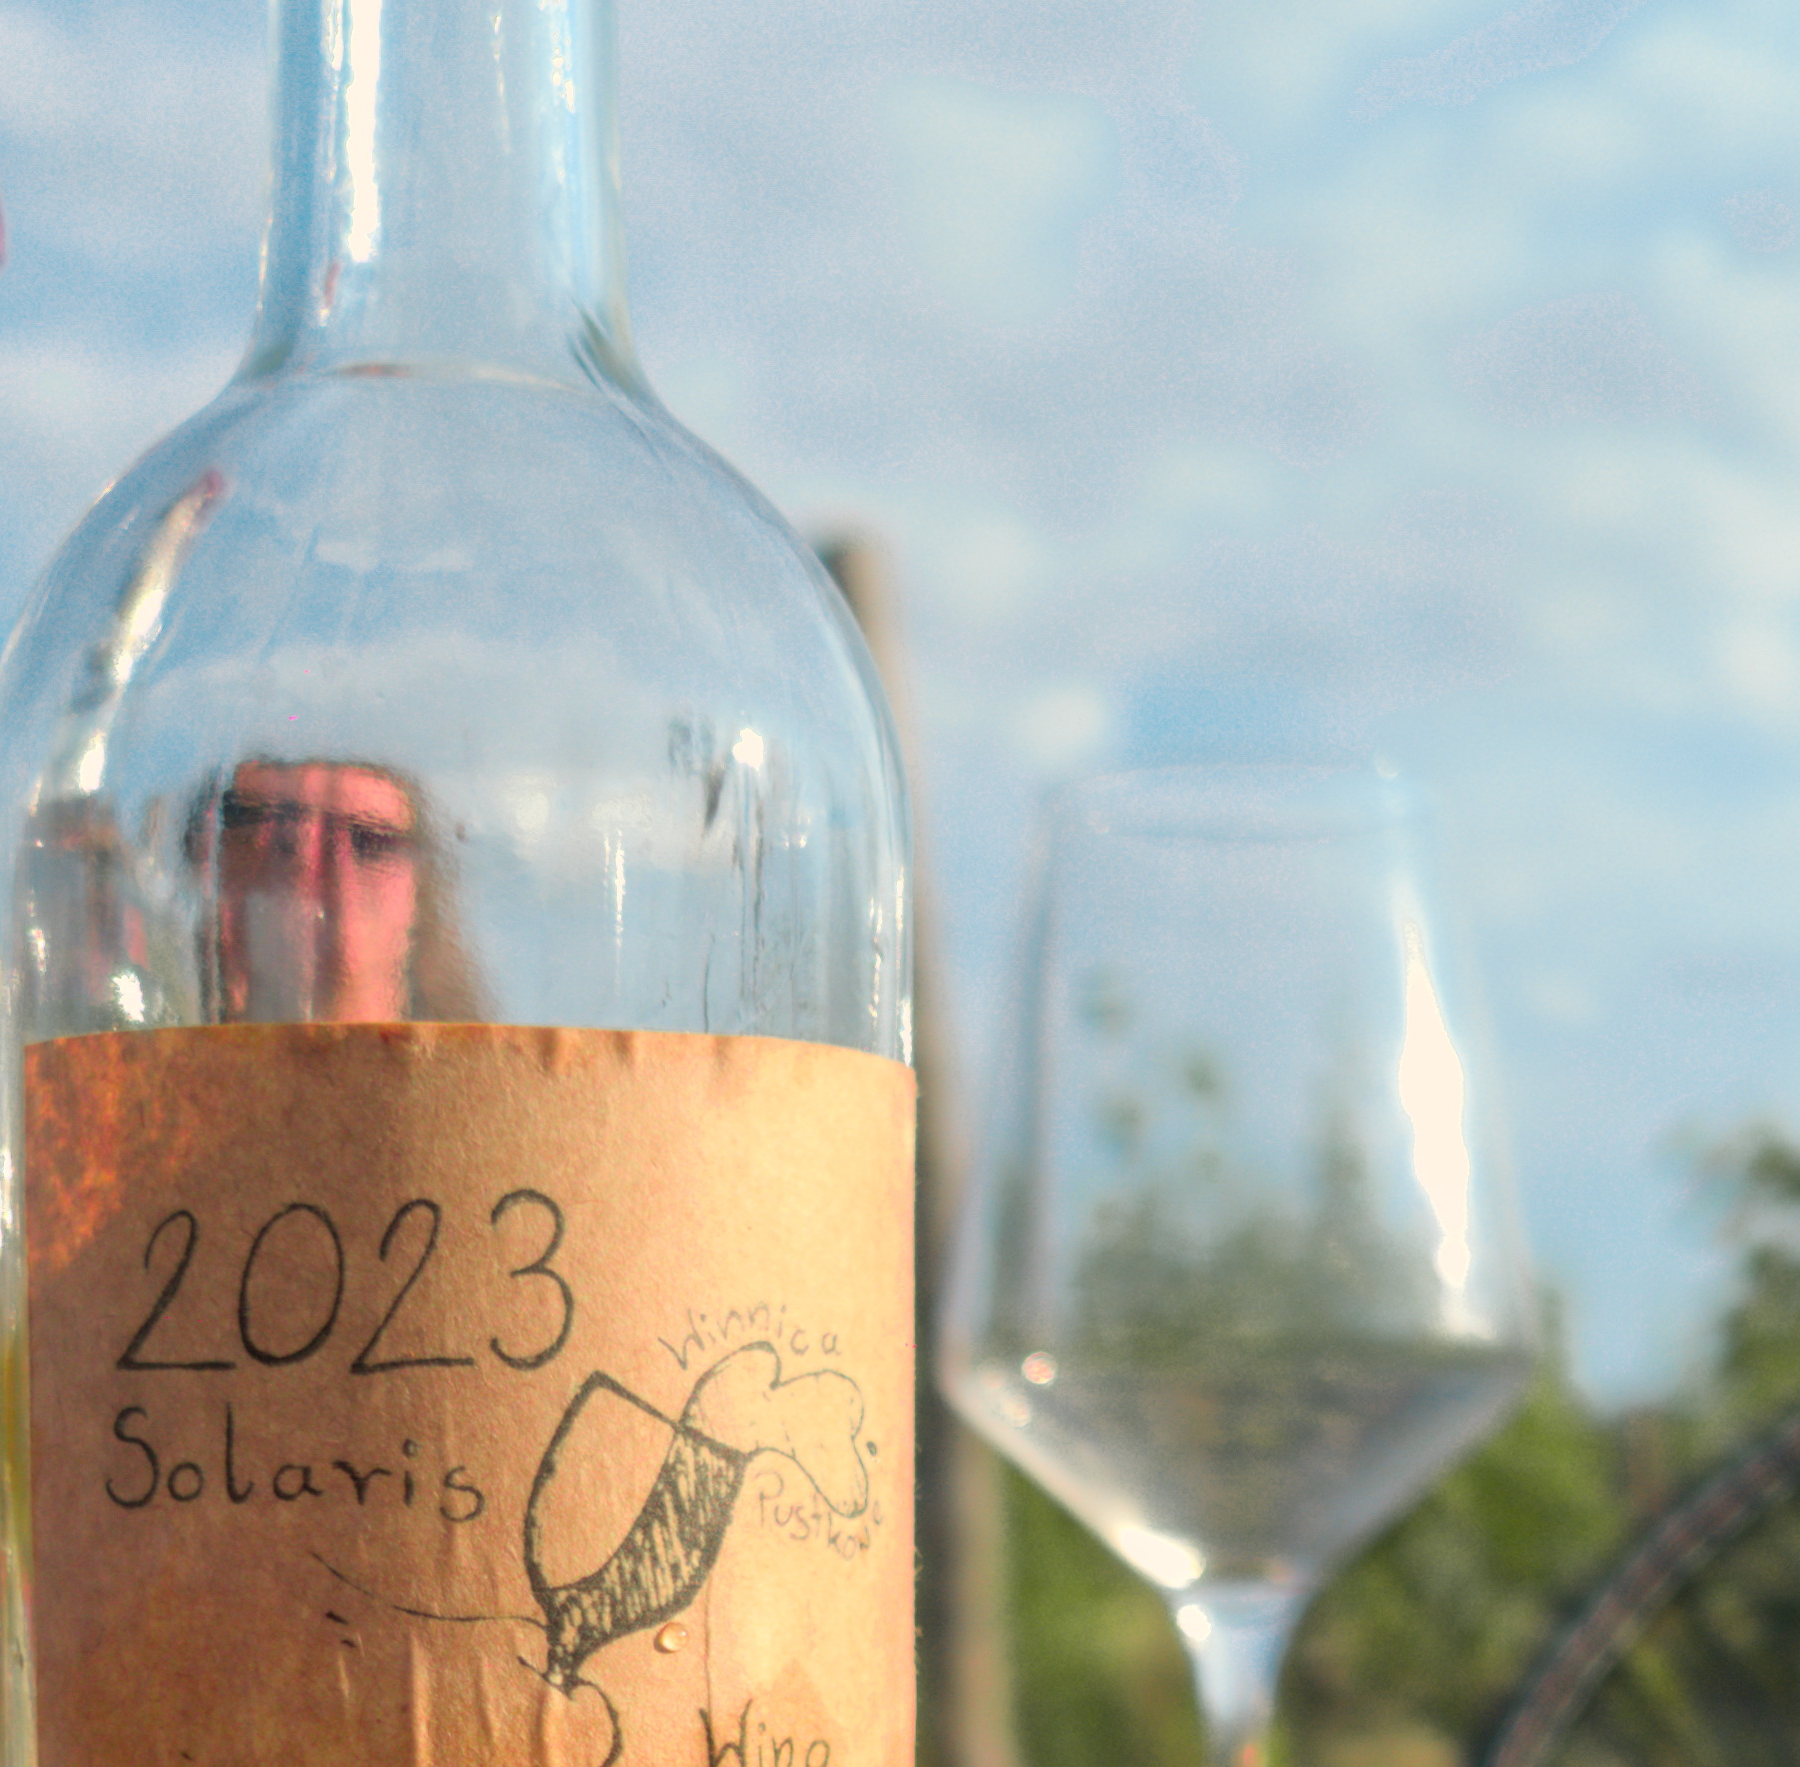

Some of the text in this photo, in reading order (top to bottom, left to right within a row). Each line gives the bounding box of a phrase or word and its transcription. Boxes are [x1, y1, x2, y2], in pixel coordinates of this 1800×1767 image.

[116, 1188, 574, 1375] 2023
[656, 1300, 842, 1372] Winnica
[105, 1402, 486, 1523] Solaris
